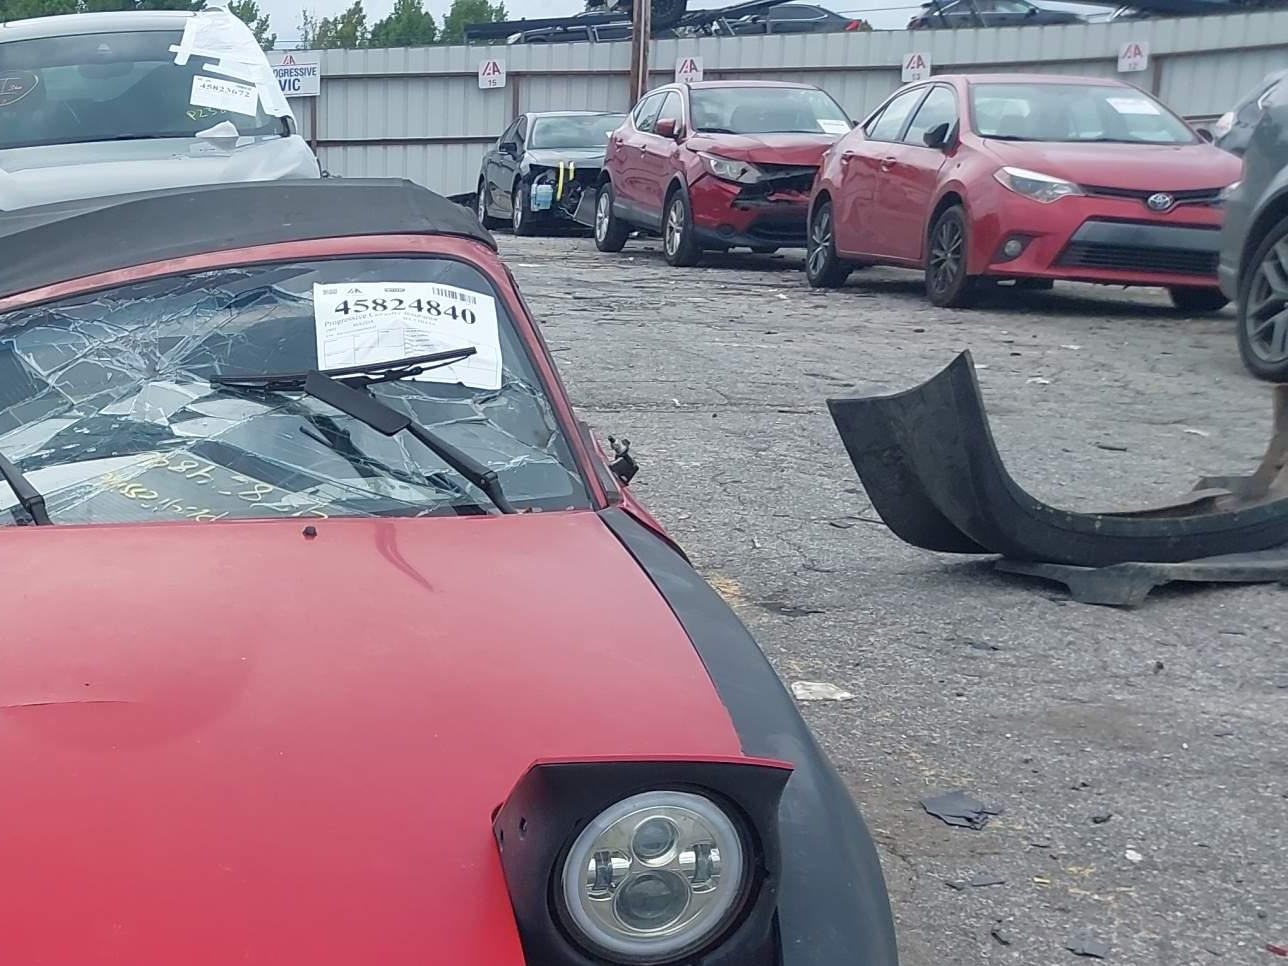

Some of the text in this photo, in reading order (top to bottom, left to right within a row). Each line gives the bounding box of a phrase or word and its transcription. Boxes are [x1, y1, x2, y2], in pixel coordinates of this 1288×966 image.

[273, 67, 317, 78] OGRESSIVE
[279, 79, 300, 91] VIC
[335, 298, 476, 324] 45824840
